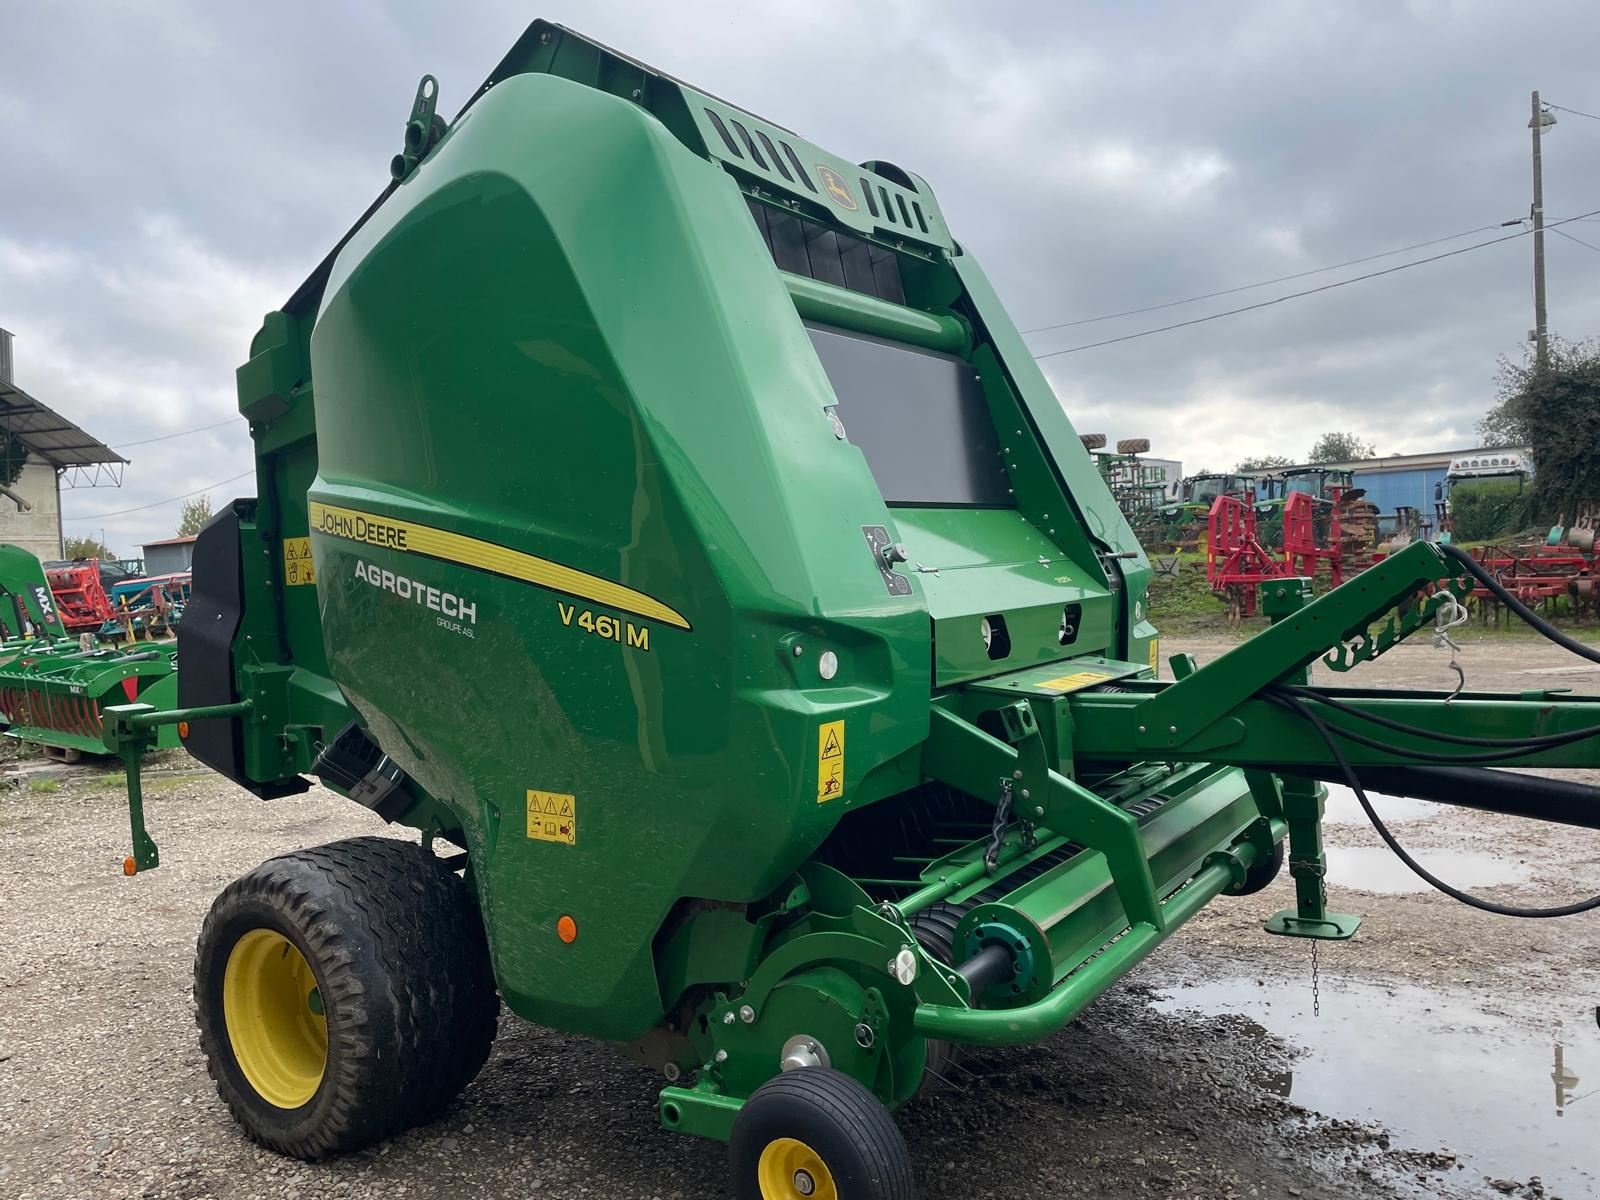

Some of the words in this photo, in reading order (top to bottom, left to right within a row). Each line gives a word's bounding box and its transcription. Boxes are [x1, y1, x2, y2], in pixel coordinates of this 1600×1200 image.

[35, 586, 53, 615] MX
[354, 559, 476, 625] AGROTECH
[436, 617, 462, 635] GROUPE
[557, 601, 576, 627] V
[577, 609, 621, 642] 461
[626, 622, 650, 652] M
